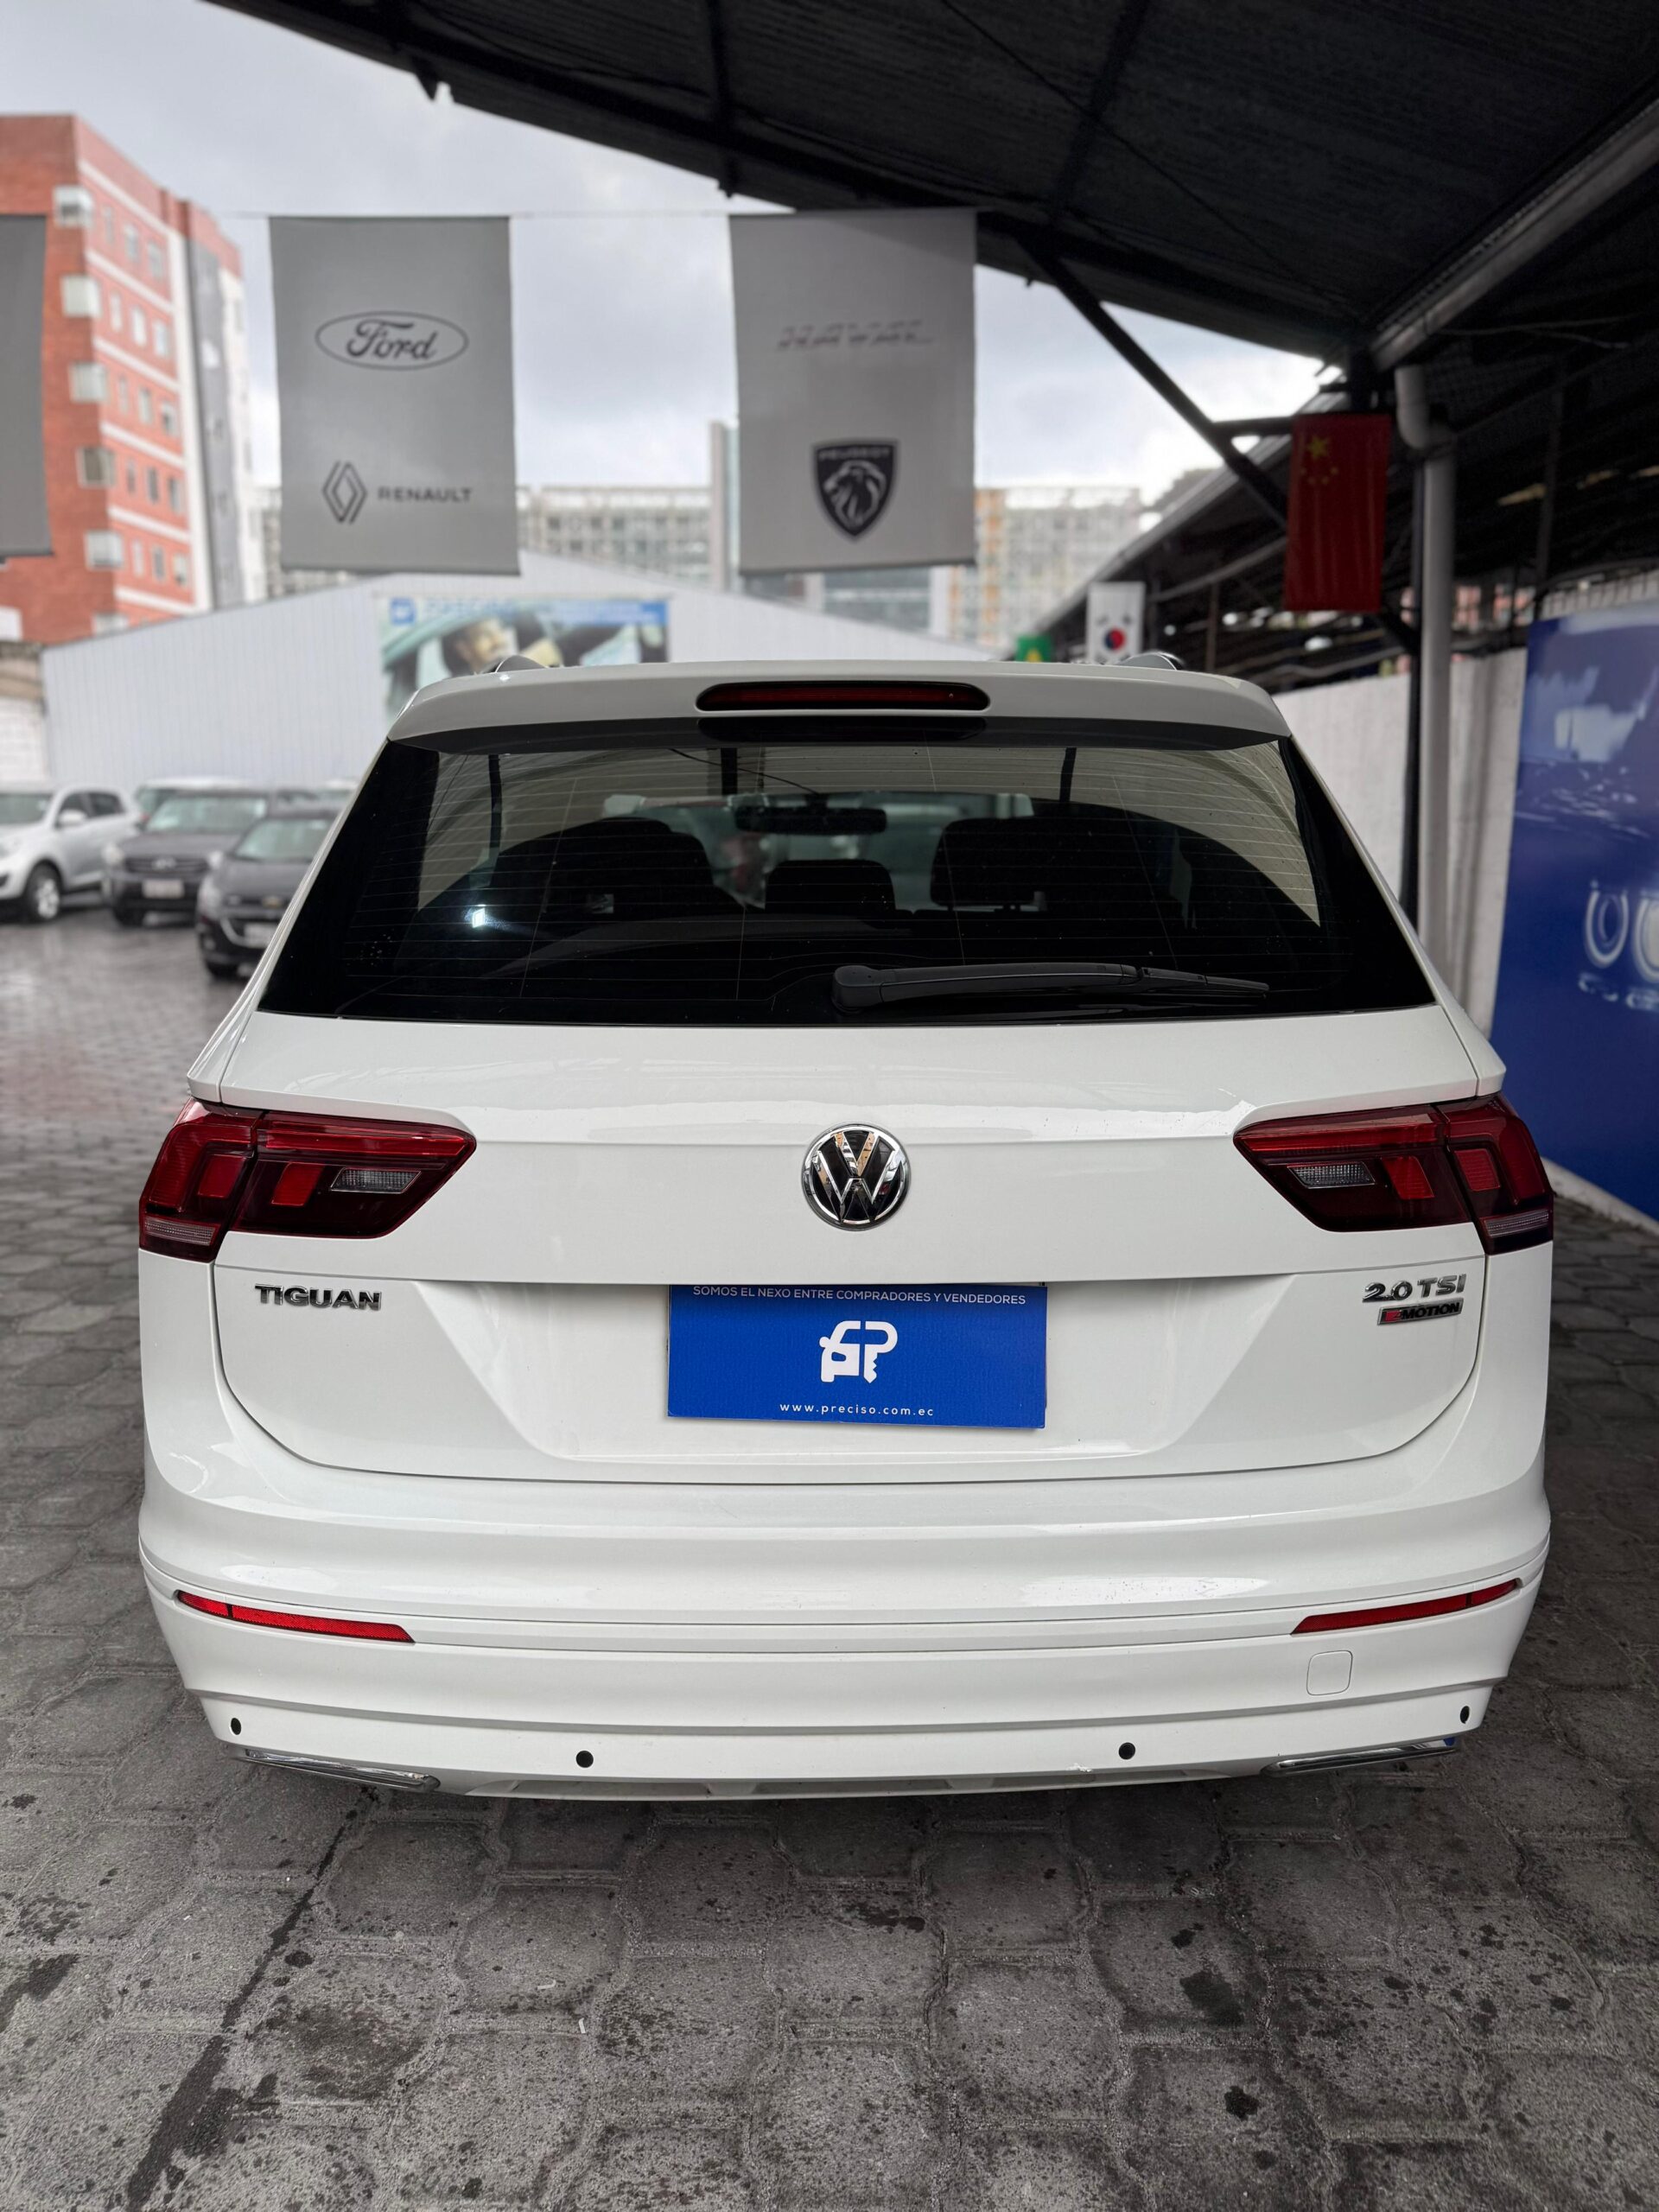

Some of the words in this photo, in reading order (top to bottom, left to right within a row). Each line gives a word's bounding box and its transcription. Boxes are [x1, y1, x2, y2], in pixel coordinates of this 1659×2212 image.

[346, 319, 437, 359] Ford
[378, 486, 472, 504] RENAULT
[255, 1283, 382, 1311] TIGUAN
[693, 1286, 738, 1297] SOMOS
[741, 1287, 755, 1297] EL
[758, 1288, 791, 1298] NEXO
[793, 1289, 834, 1300] ENTRE
[836, 1290, 931, 1303] COMPRADORES
[933, 1293, 942, 1302] Y
[943, 1294, 1026, 1305] VENDEDORES
[1362, 1281, 1414, 1303] 2.0
[1417, 1274, 1467, 1298] TSI
[780, 1404, 934, 1416] www.preciso.com.ec
